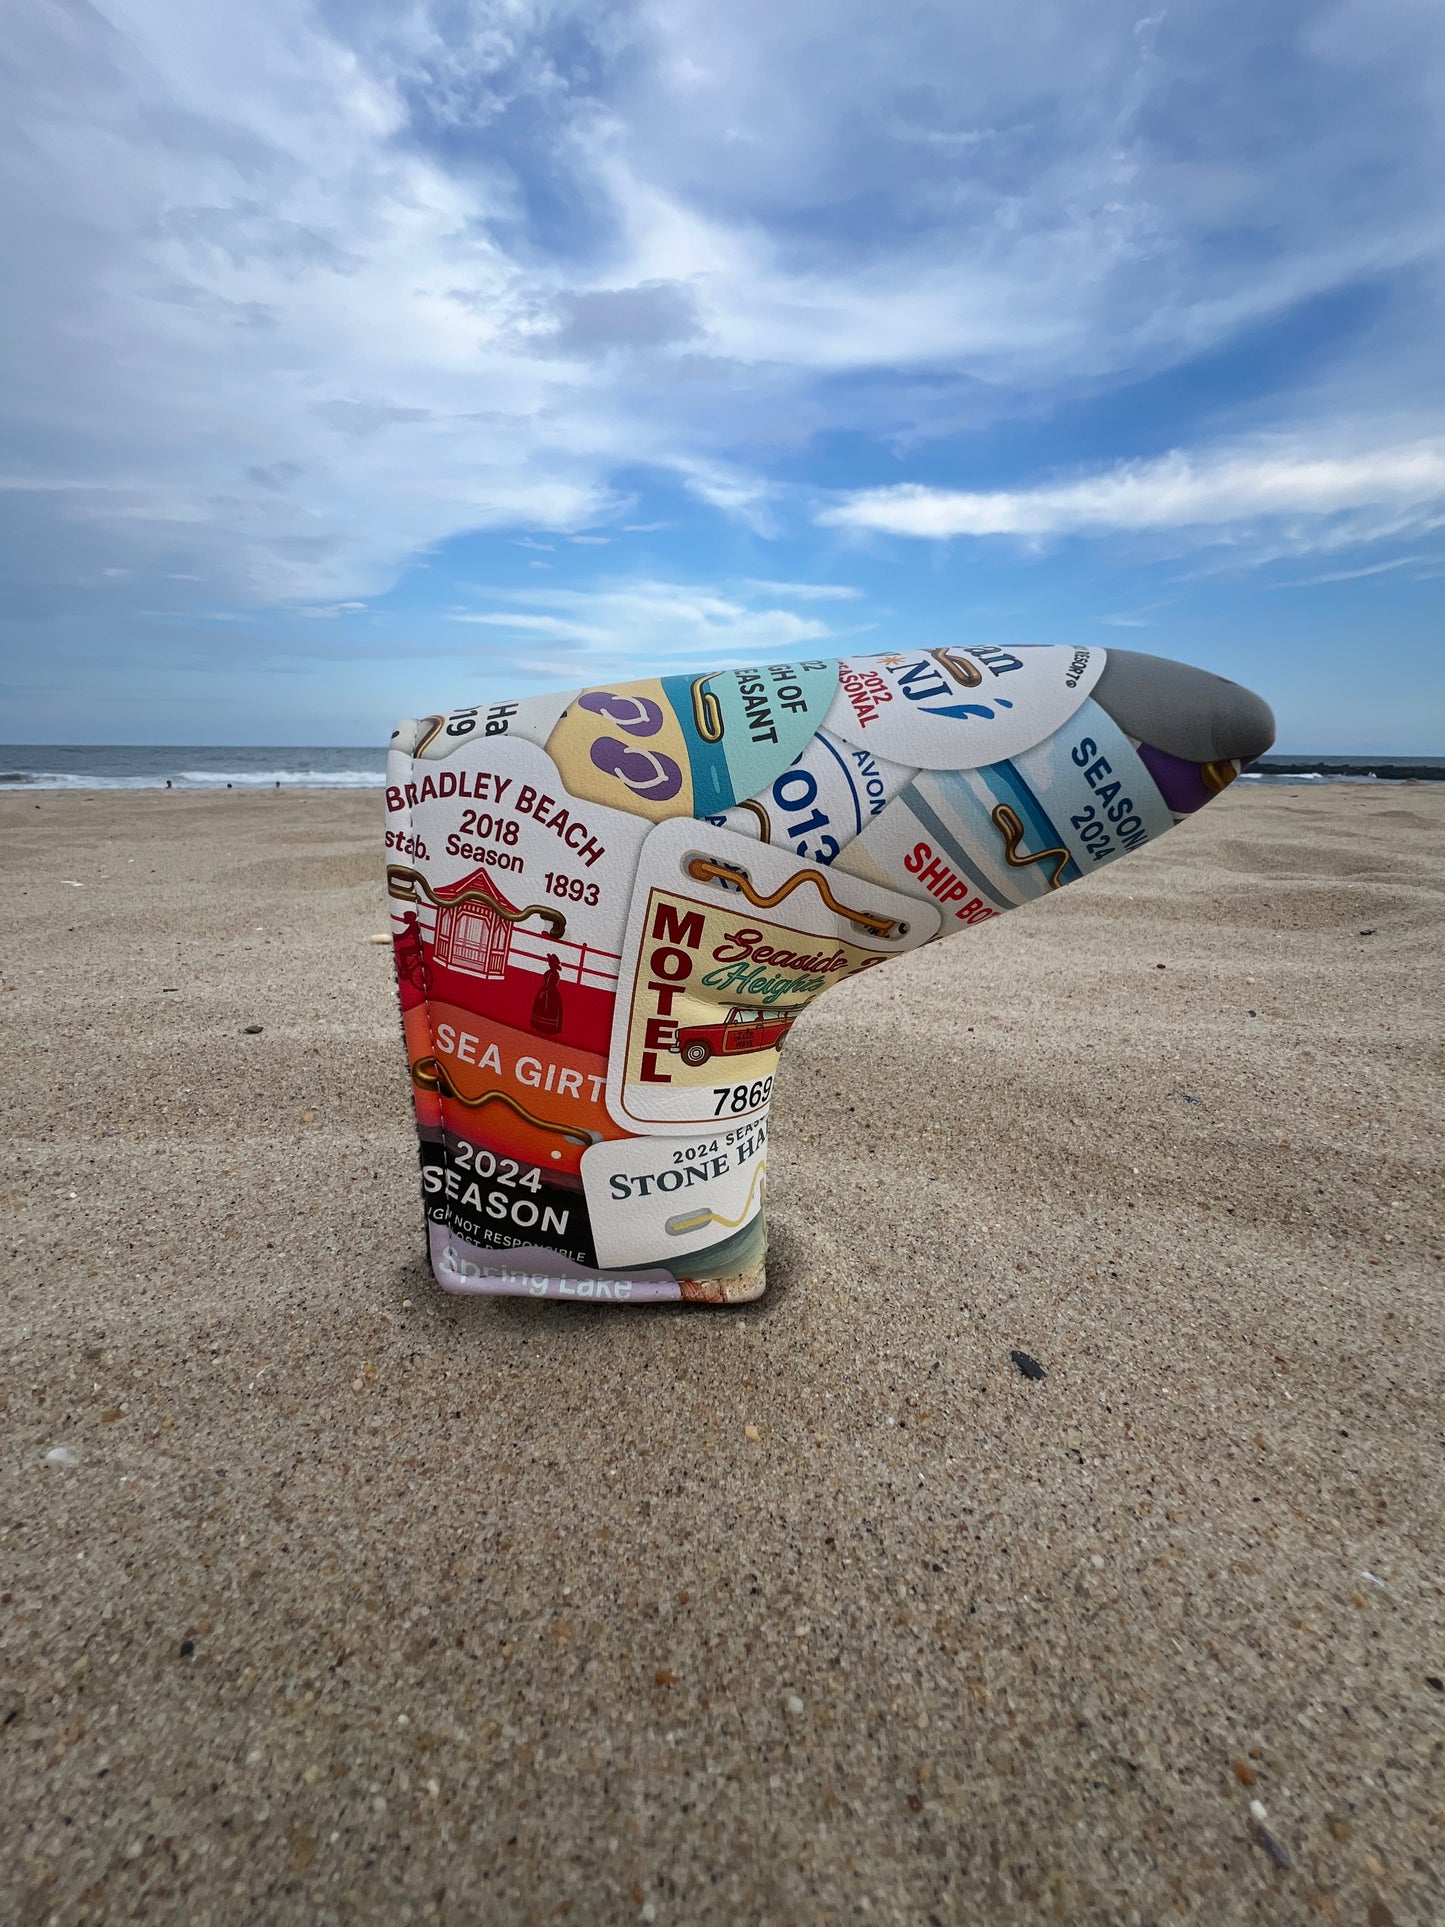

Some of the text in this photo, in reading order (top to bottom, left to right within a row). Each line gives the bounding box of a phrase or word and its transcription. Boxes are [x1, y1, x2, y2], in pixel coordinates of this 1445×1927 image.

[886, 660, 953, 701] NJ
[963, 646, 1024, 678] an
[777, 685, 808, 714] OF
[858, 670, 894, 705] 2012
[446, 705, 482, 737] 19
[485, 703, 519, 737] Ha
[852, 750, 887, 815] AVON
[1071, 737, 1149, 854] SEASON
[385, 771, 605, 868] BRADLEY BEACH
[459, 809, 520, 846] 2018
[1070, 805, 1116, 862] 2024
[445, 833, 525, 874] Season
[904, 842, 969, 904] SHIP
[544, 872, 601, 907] 1893
[712, 928, 849, 973] Seaside
[639, 902, 706, 1084] MOTEL
[701, 962, 826, 1005] Heights
[436, 1023, 608, 1103] SEA GIRT
[712, 1076, 774, 1116] 7869
[454, 1140, 543, 1194] 2024
[609, 1118, 768, 1200] STONE HA
[672, 1139, 719, 1165] 2024
[422, 1165, 570, 1236] SEASON
[454, 1214, 482, 1236] NOT
[438, 1246, 633, 1299] Spring Lake
